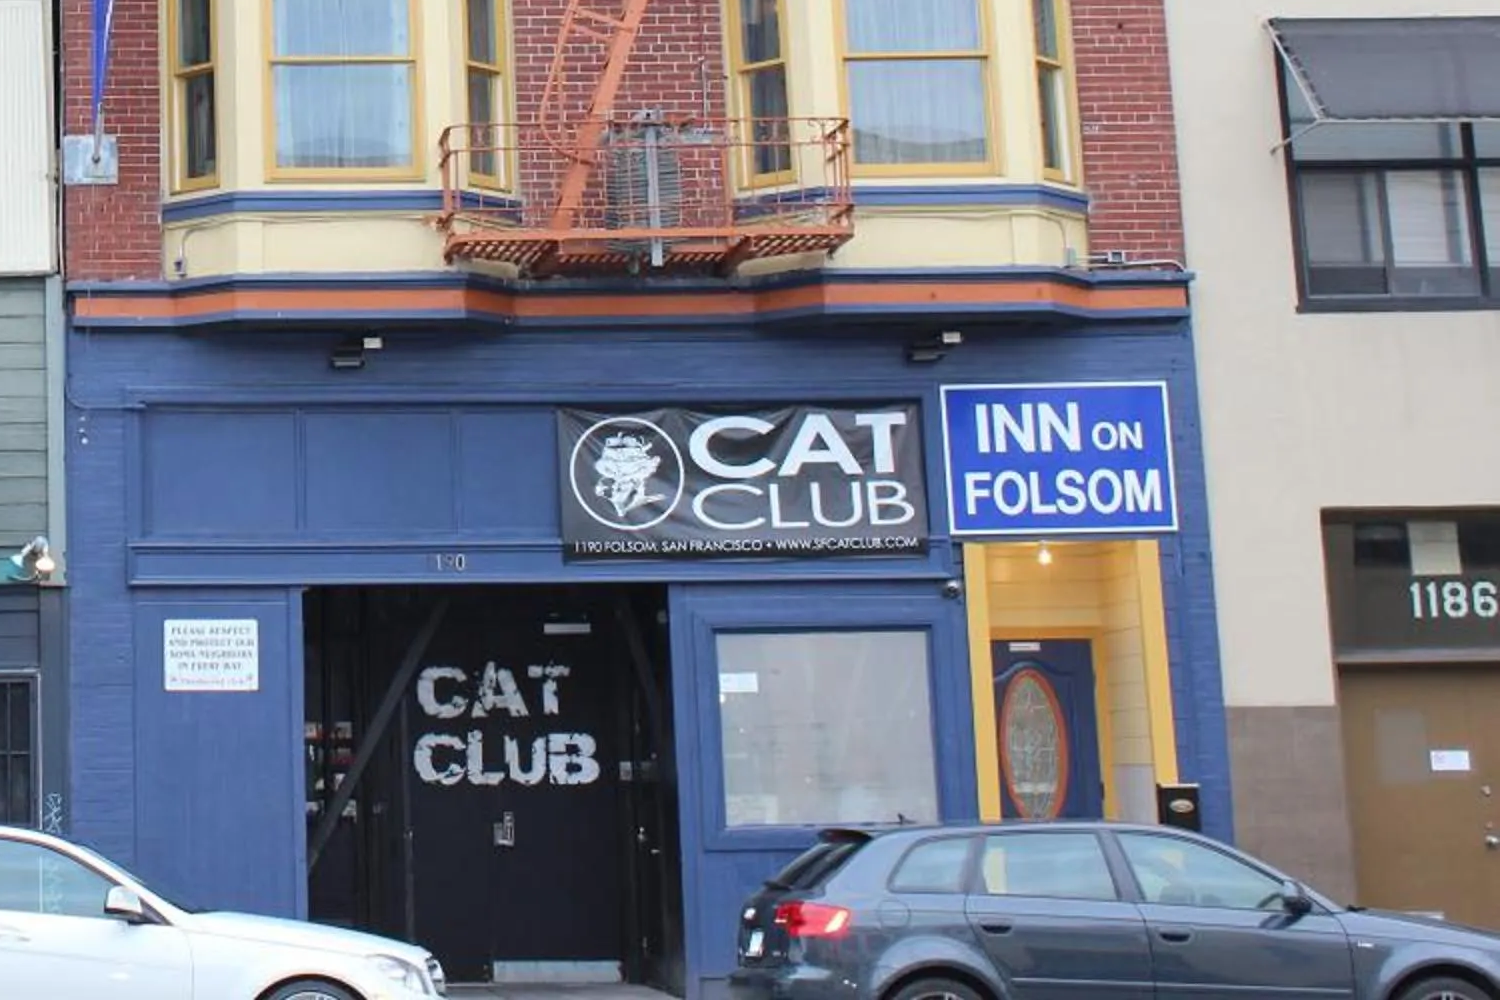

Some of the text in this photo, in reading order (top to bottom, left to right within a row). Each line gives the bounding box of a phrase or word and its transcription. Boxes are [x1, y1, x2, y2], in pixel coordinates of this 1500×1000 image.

[688, 411, 907, 479] CAT
[975, 401, 1144, 453] INN ON
[691, 479, 915, 531] CLUB
[964, 468, 1163, 516] FOLSOM
[574, 541, 601, 553] 1190
[661, 540, 688, 552] SAN
[690, 539, 763, 551] FRANCISCO
[1409, 581, 1498, 618] 1186
[416, 660, 571, 719] CAT
[413, 729, 600, 786] CLUB
